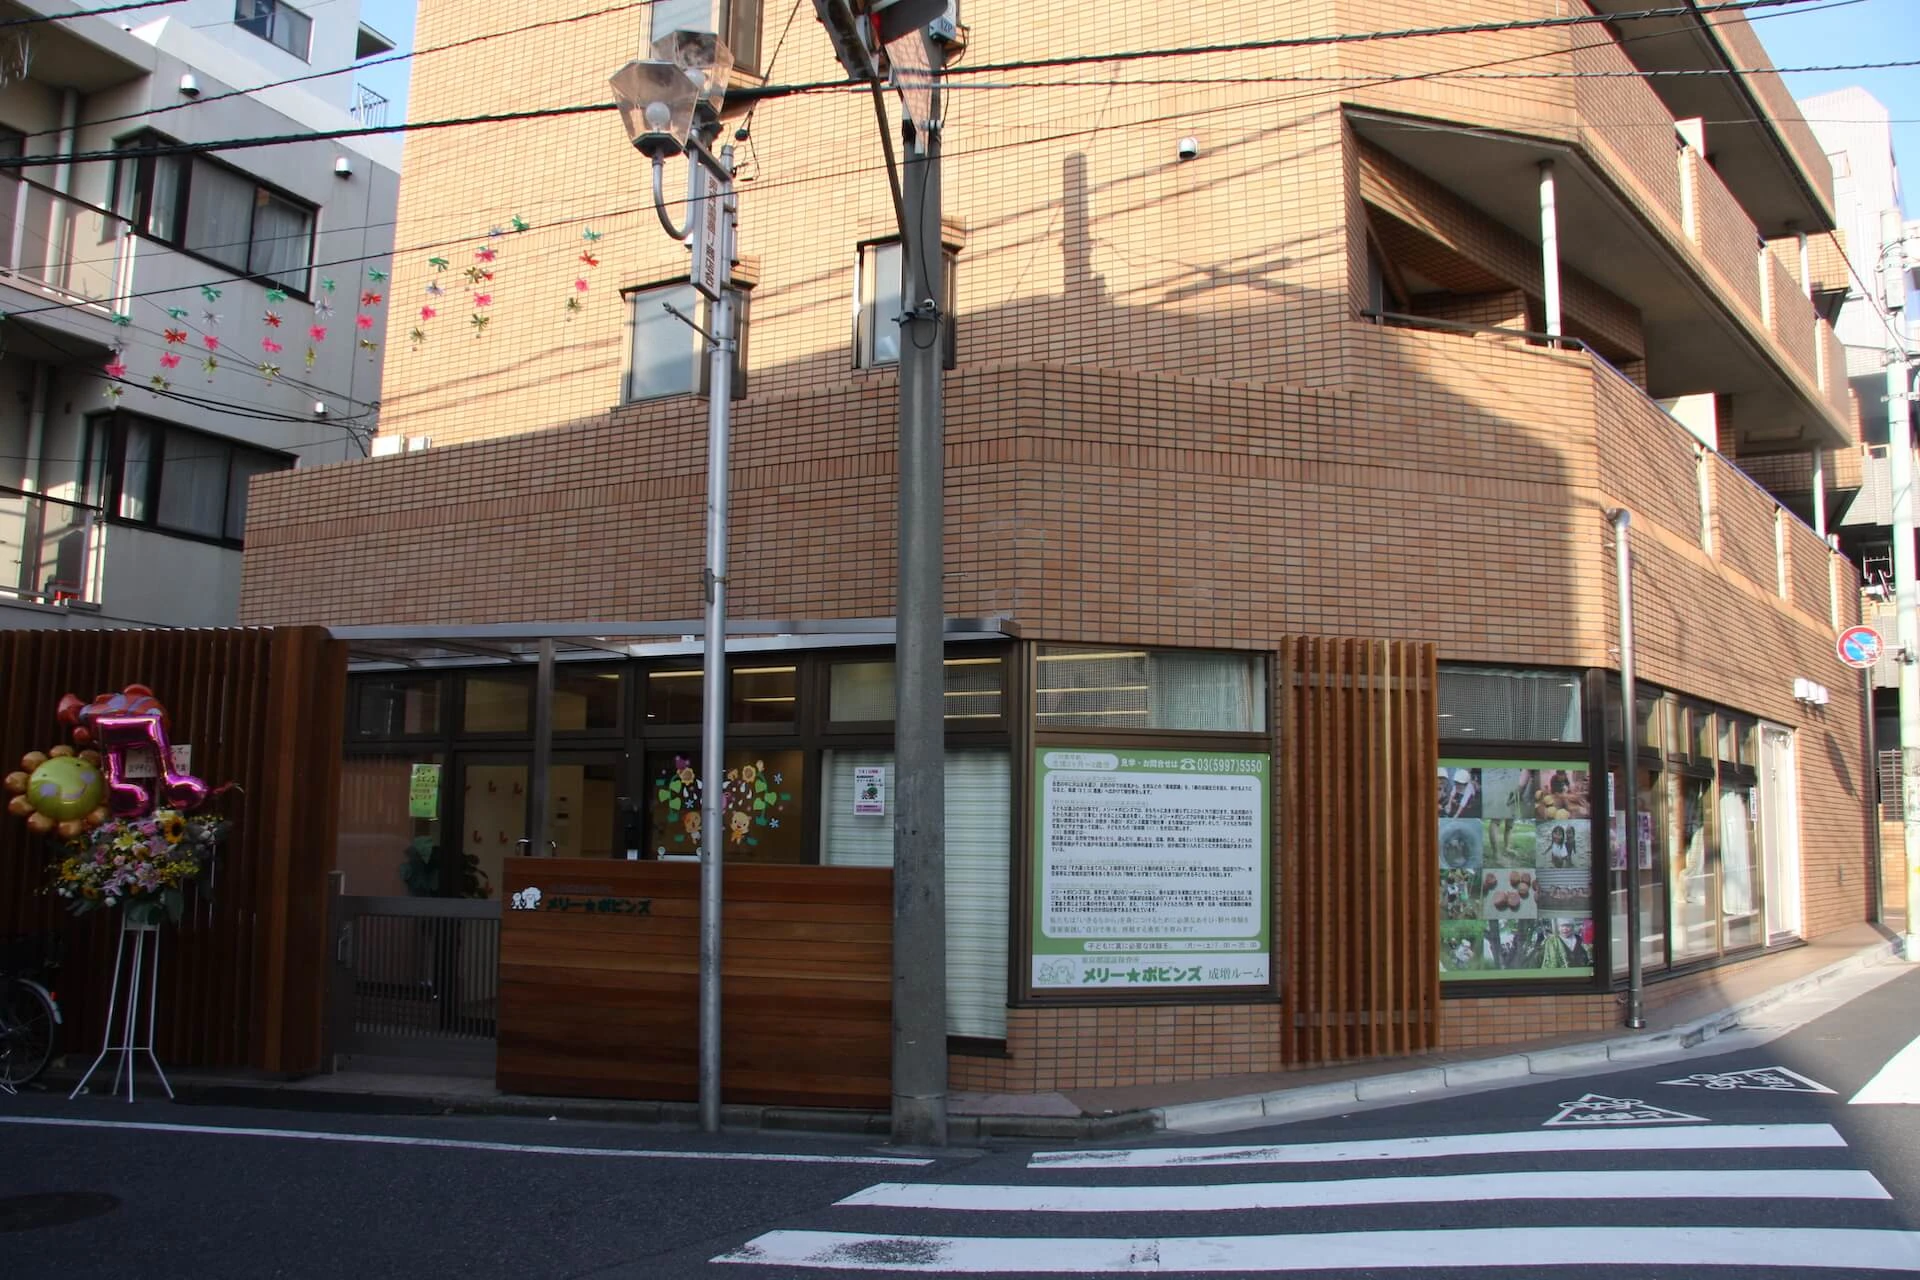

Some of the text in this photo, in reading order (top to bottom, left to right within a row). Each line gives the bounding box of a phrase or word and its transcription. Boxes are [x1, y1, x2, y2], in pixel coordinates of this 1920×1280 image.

[1208, 967, 1265, 980] 成増ルーム
